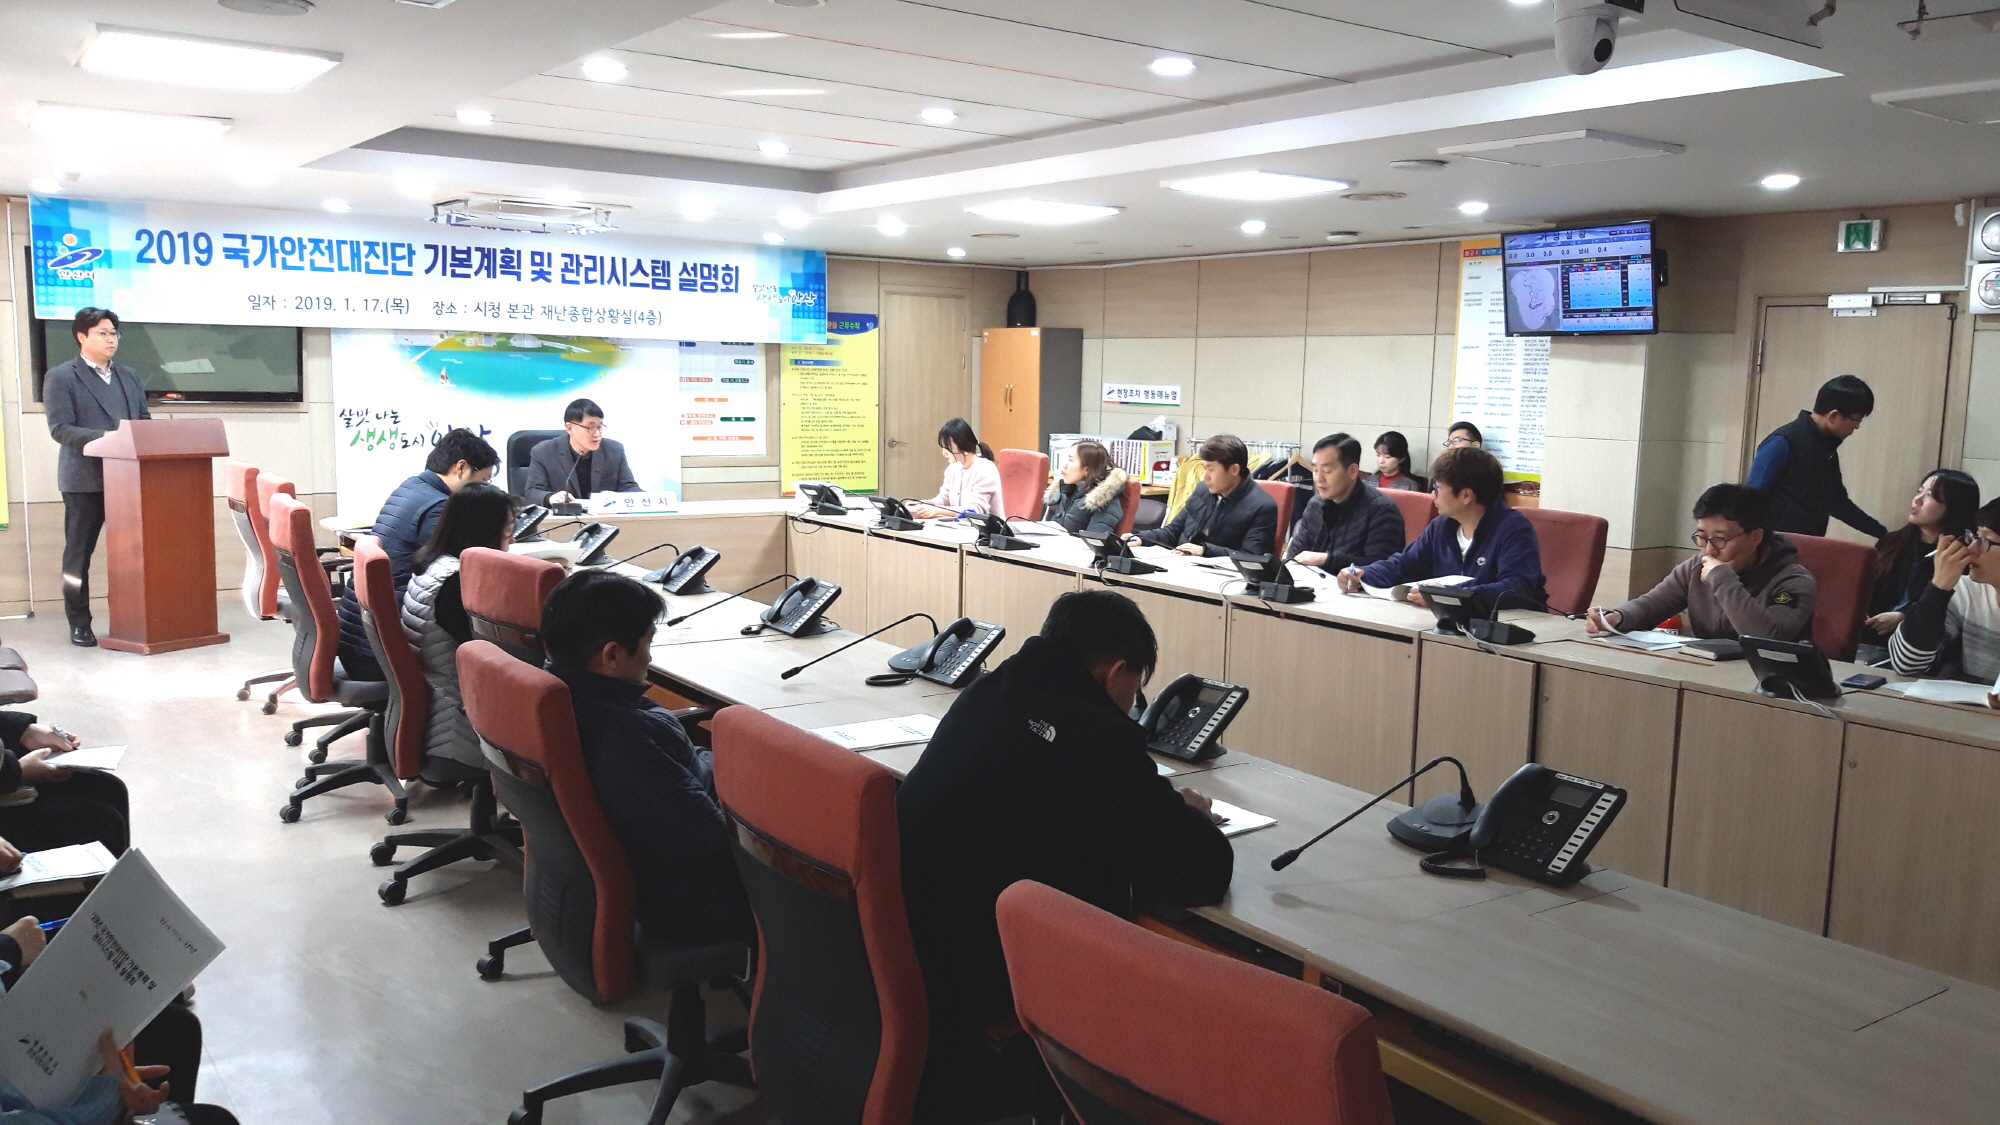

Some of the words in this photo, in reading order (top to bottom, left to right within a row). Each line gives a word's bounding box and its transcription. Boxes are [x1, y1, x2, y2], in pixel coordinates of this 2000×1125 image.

[135, 229, 213, 267] 2019
[222, 232, 416, 276] 국가안전대진단
[424, 243, 522, 282] 기본계획
[530, 250, 552, 284] 및
[560, 252, 671, 291] 관리시스템
[678, 260, 740, 294] 설명회
[58, 270, 95, 281] 안산시
[247, 294, 277, 310] 일자
[295, 296, 336, 311] 2019.
[344, 297, 356, 312] 1.
[363, 298, 410, 315] 17.(목)
[432, 301, 459, 315] 장소
[473, 301, 502, 319] 시청
[507, 303, 536, 320] 본관
[540, 304, 663, 326] 재난종합상황실(4층)
[1117, 388, 1141, 398] 현장조치
[1143, 390, 1178, 400] 행동매뉴얼
[339, 408, 370, 428] 살맛
[375, 409, 401, 425] 나는
